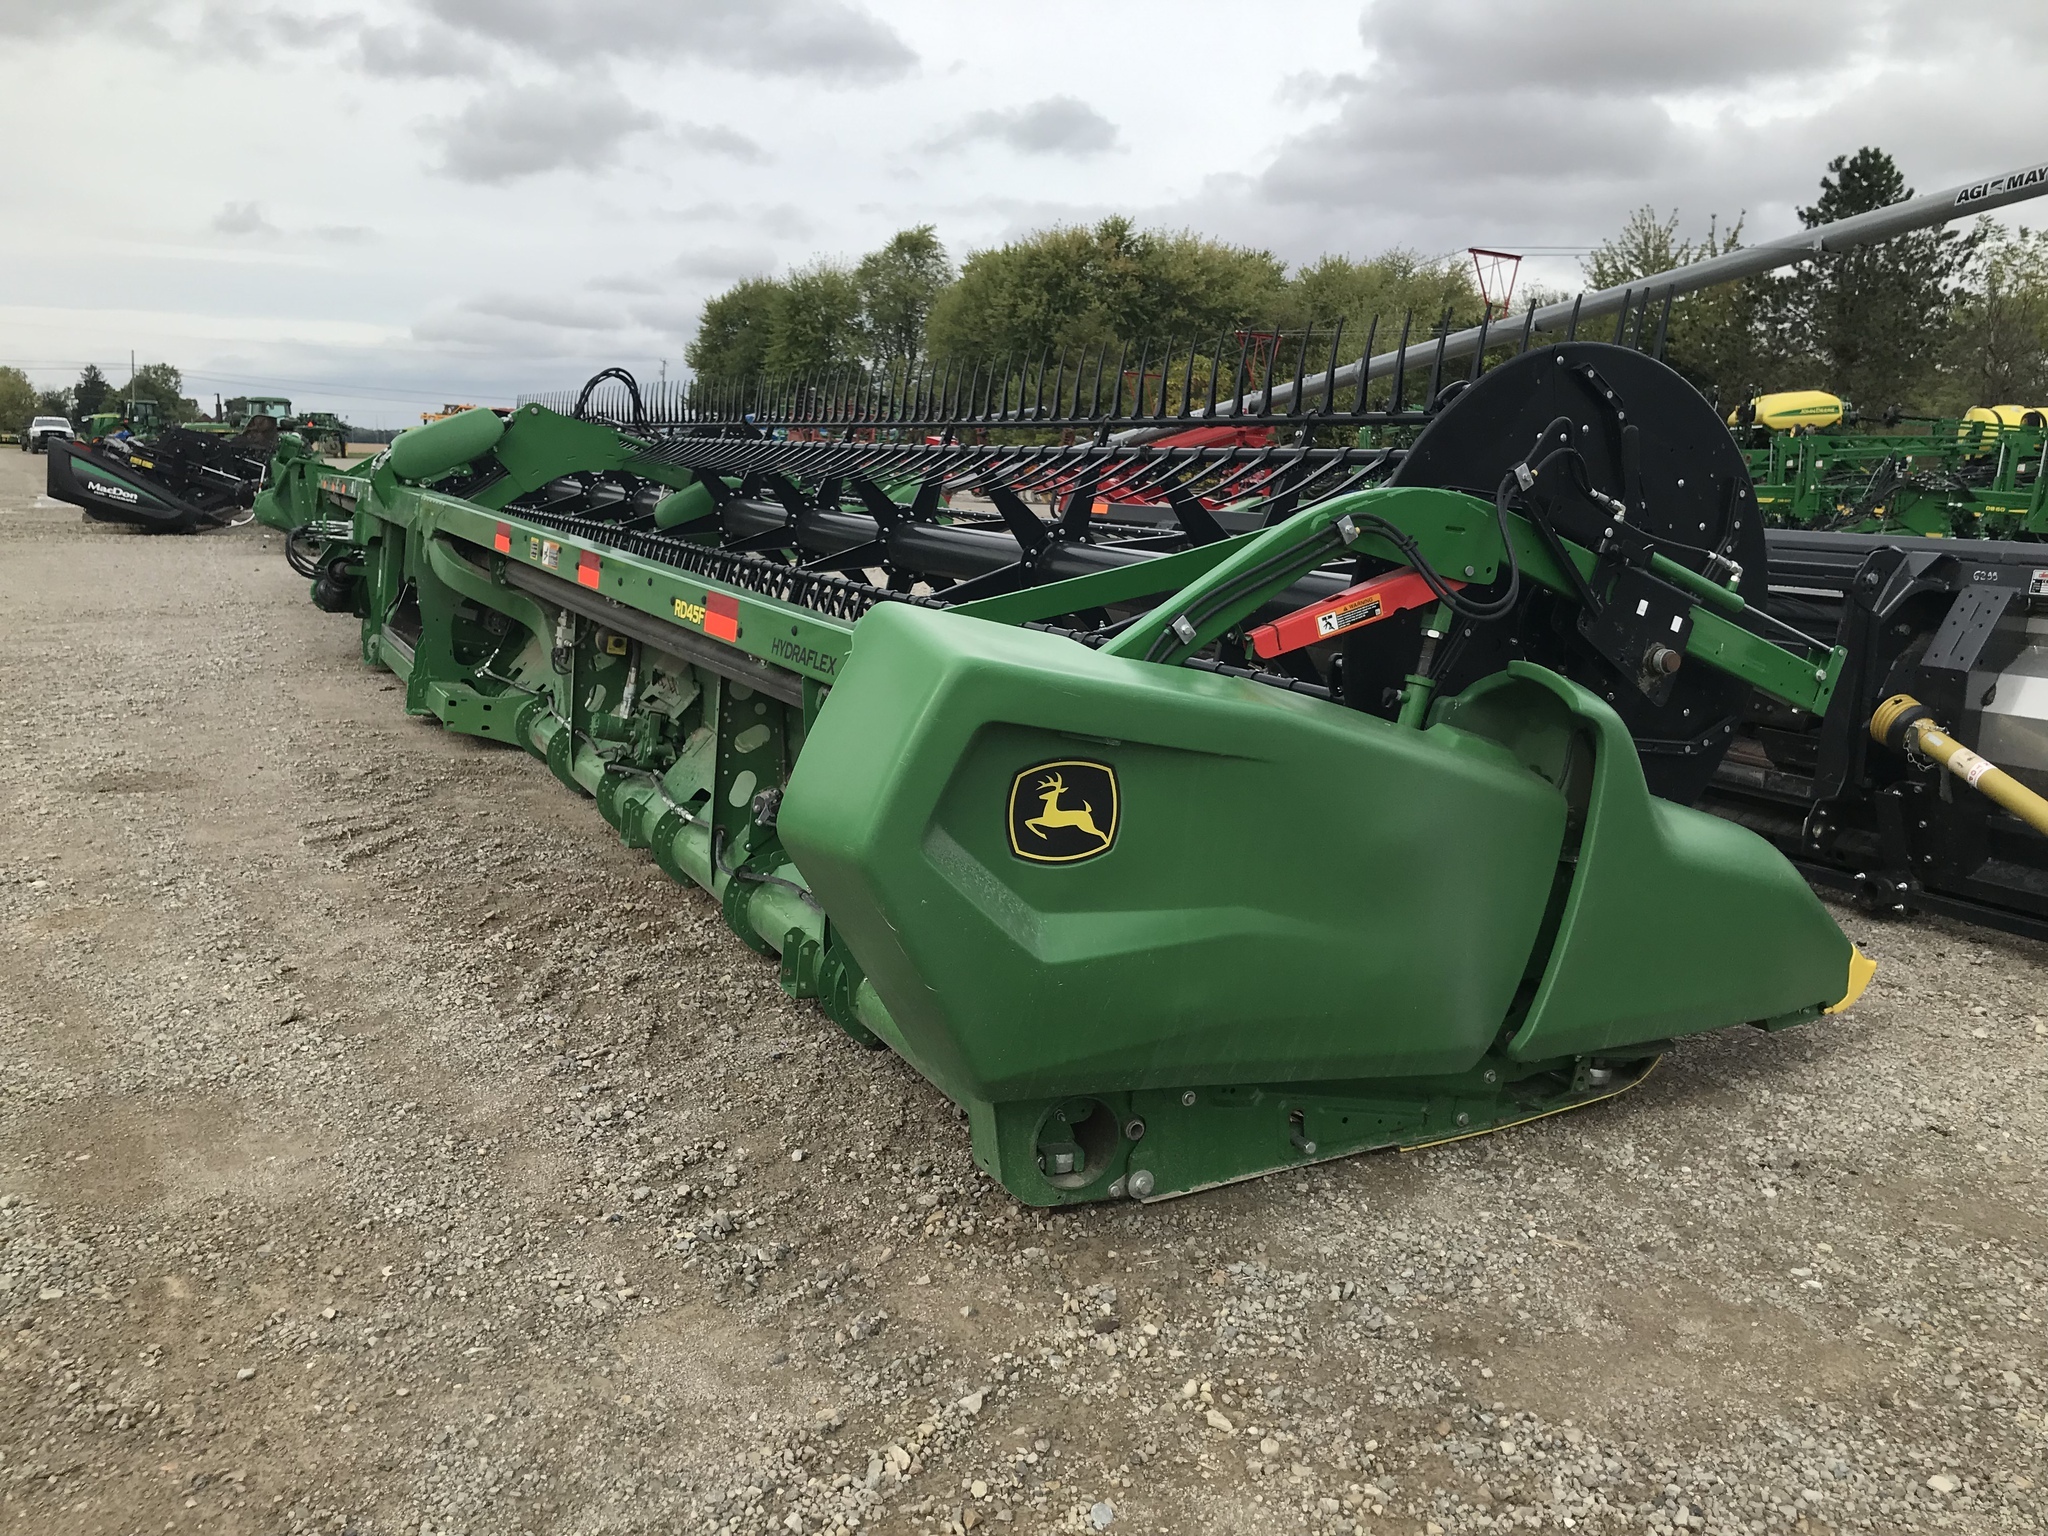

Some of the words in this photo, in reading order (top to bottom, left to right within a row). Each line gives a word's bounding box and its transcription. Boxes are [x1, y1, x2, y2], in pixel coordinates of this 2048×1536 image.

[1956, 182, 1990, 204] AGI
[87, 481, 138, 500] MacDon
[674, 598, 706, 625] RD45F
[1349, 597, 1374, 609] WARNING
[772, 637, 837, 676] HYDRAFLEX
